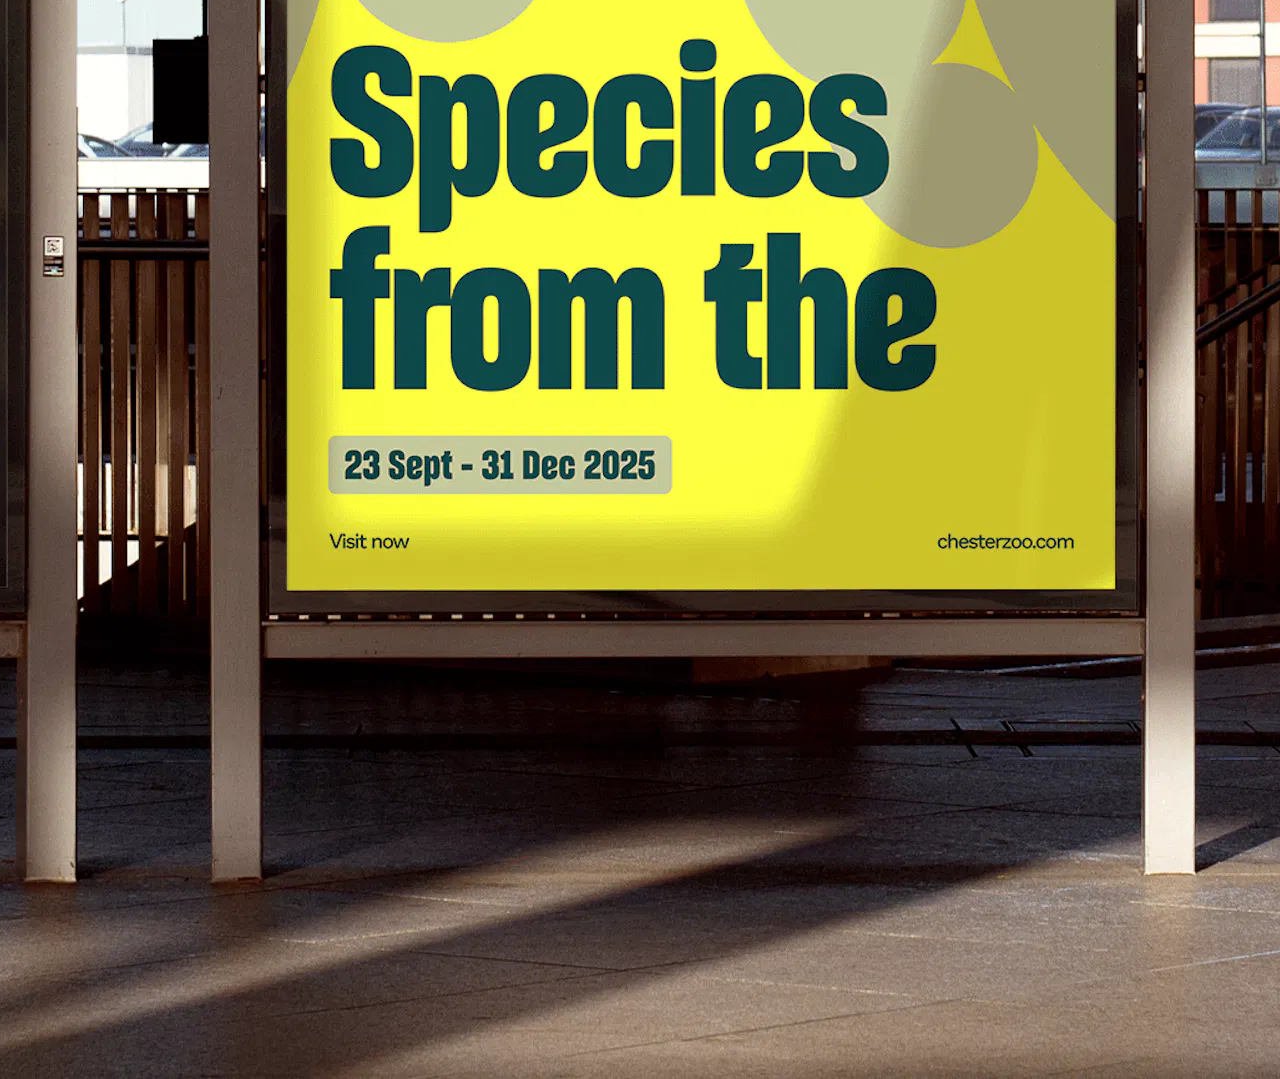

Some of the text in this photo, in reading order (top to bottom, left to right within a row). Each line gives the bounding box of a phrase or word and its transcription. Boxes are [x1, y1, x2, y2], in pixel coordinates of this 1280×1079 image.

[329, 38, 890, 234] Species
[329, 225, 937, 393] from the
[344, 449, 381, 480] 23
[388, 449, 453, 485] Sept
[481, 449, 514, 480] 31
[522, 450, 576, 480] Dec
[583, 449, 656, 480] 2025
[329, 533, 410, 550] Visit now
[937, 533, 1075, 550] chesterzoo.com
